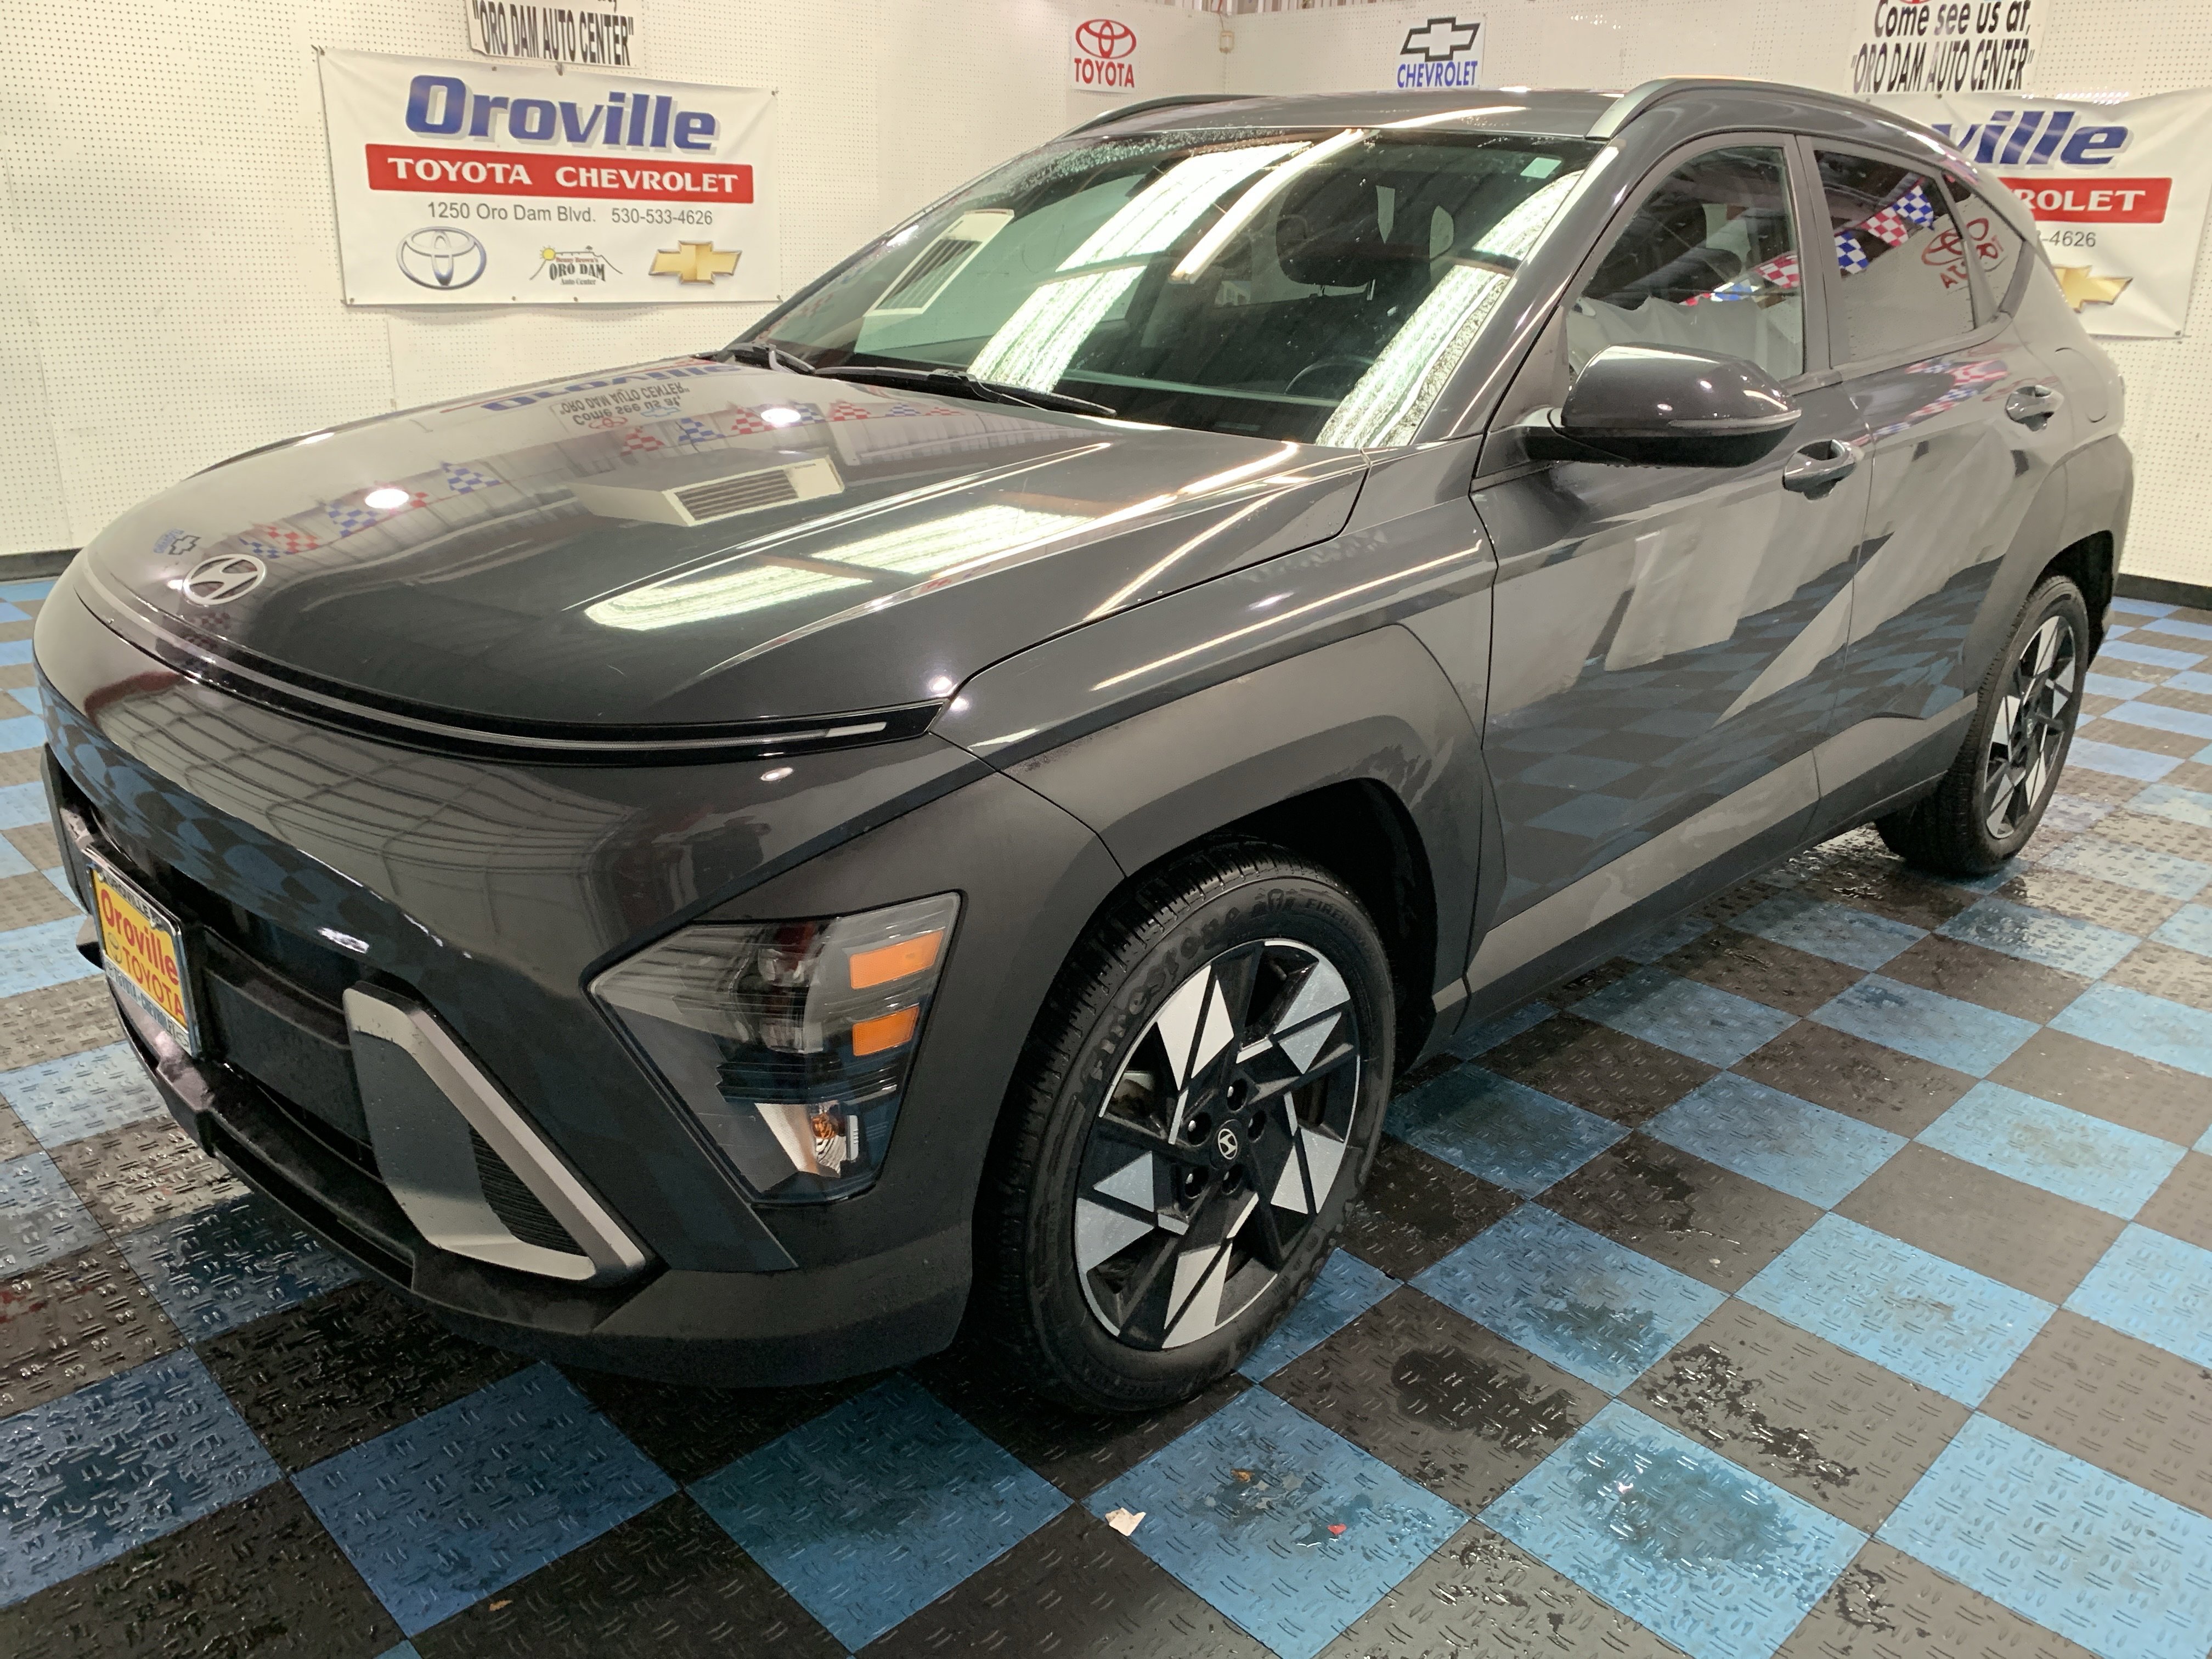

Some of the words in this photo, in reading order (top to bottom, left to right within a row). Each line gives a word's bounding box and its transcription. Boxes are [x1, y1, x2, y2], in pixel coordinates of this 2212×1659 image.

[472, 0, 508, 56] "ORO
[510, 3, 539, 58] DAM
[543, 7, 575, 62] AUTO
[579, 10, 634, 66] CENTER"
[1874, 0, 1930, 38] Come
[1934, 3, 1971, 36] see
[1976, 1, 2001, 34] us
[2006, 0, 2031, 35] at,
[1074, 58, 1135, 88] TOYOTA
[1397, 60, 1478, 88] CHEVROLET
[1850, 42, 1888, 94] "ORO
[1887, 41, 1927, 93] DAM
[1925, 38, 1971, 93] AUTO
[1971, 38, 2035, 92] CENTER"
[405, 75, 716, 150] Oroville
[1931, 110, 2129, 165] ville
[387, 157, 533, 185] TOYOTA
[555, 166, 739, 193] CHEVROLET
[427, 201, 470, 219] 1250
[476, 203, 507, 220] Oro
[514, 204, 551, 222] Dam
[557, 205, 596, 223] Blvd.
[611, 207, 713, 225] 530-533-4626
[2012, 189, 2146, 211] ROLET
[549, 263, 575, 281] ORO
[579, 263, 606, 282] DAM
[101, 888, 179, 986] Oroville
[122, 945, 185, 1022] TOYOTA
